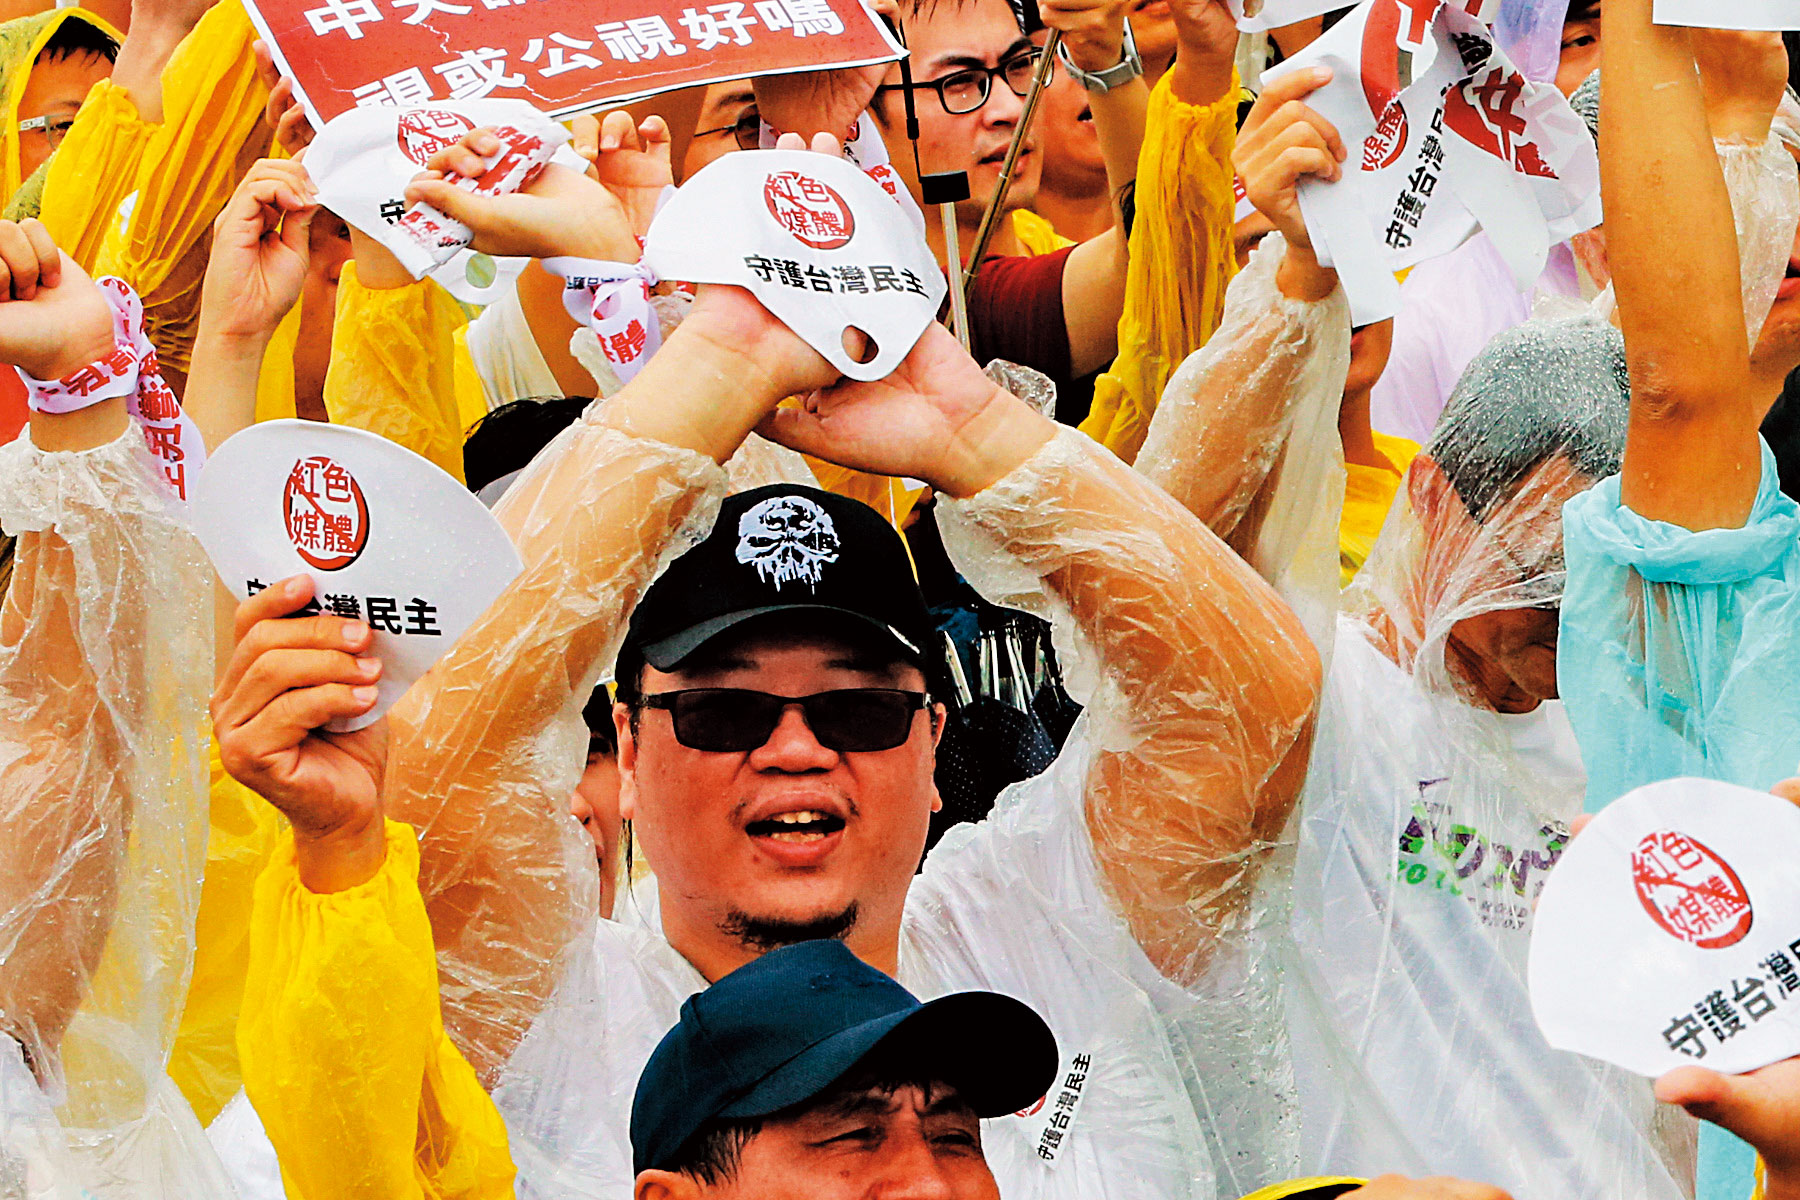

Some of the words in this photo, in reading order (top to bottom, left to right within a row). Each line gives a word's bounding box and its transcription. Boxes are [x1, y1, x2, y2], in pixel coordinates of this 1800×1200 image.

[766, 173, 830, 202] 紅色
[780, 206, 845, 239] 媒體
[743, 253, 930, 298] 守護台灣民主
[292, 457, 354, 502] 紅色
[290, 508, 357, 556] 媒體
[1631, 830, 1704, 889] 紅色
[1665, 874, 1749, 946] 媒體
[1036, 1053, 1092, 1162] 守護台灣民主
